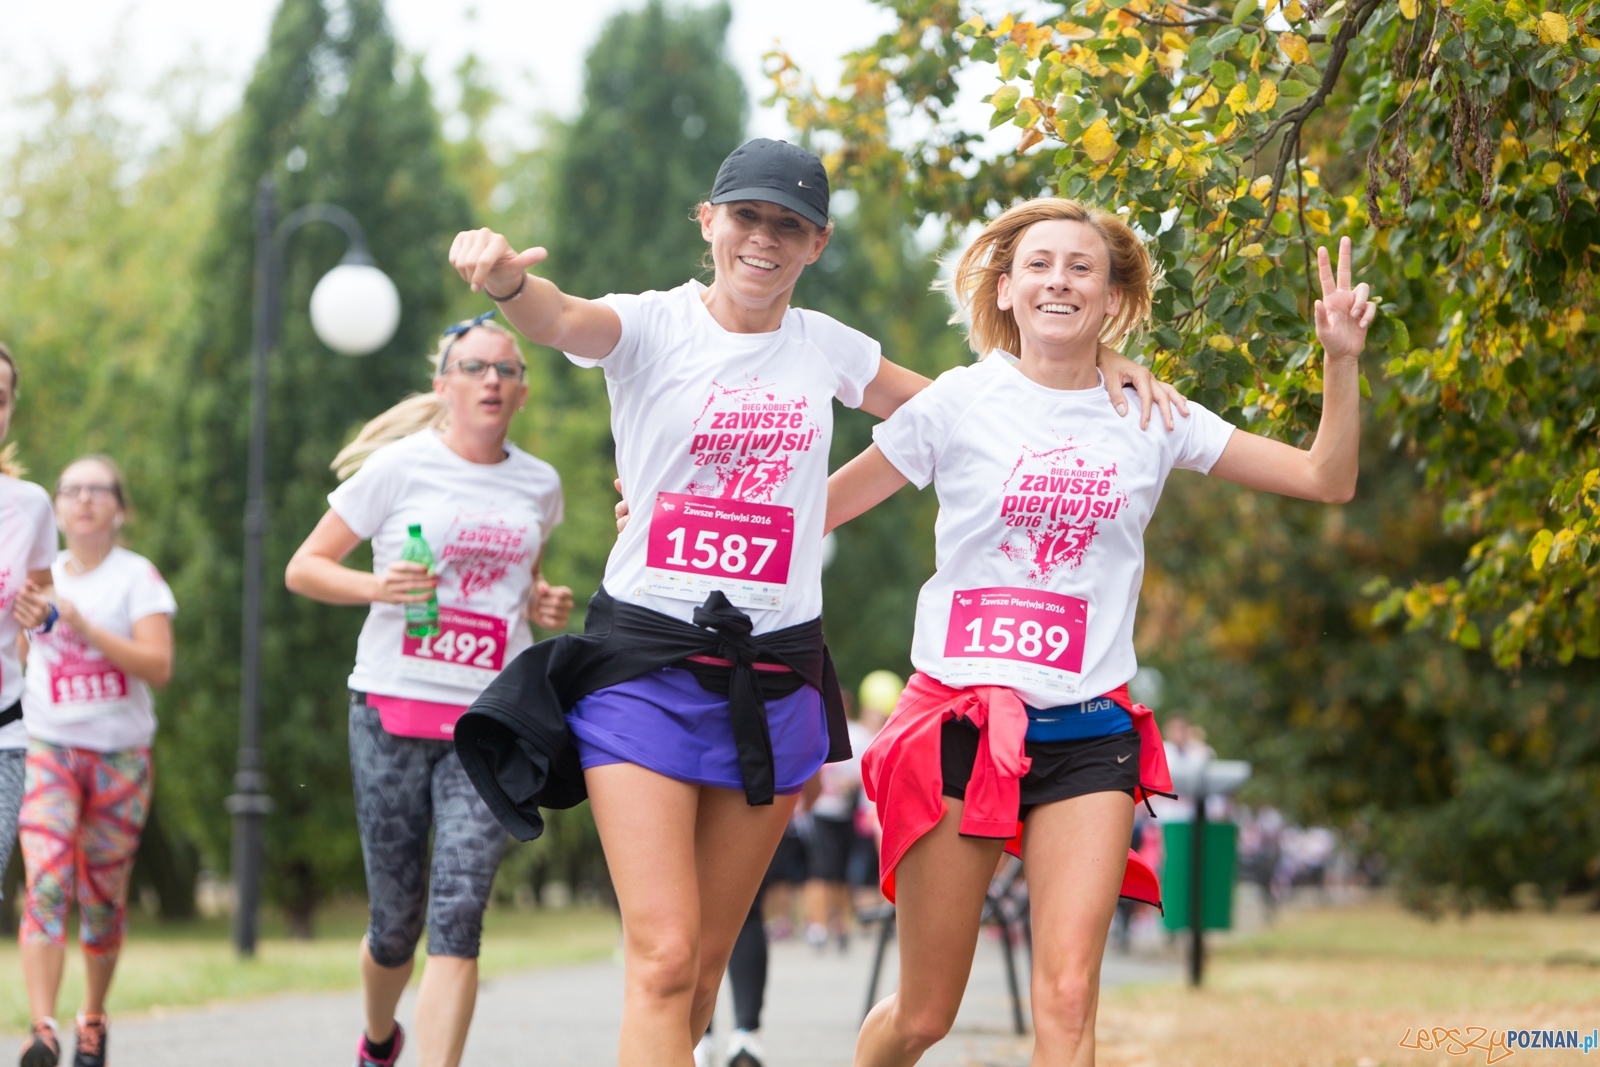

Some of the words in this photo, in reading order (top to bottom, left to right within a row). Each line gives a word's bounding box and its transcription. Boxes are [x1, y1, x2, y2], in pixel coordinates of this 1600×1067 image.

[742, 403, 761, 411] BIEG
[762, 403, 792, 411] KOBIET
[710, 411, 803, 430] zawsze
[689, 428, 815, 458] pier(w)si!
[694, 452, 733, 467] 2016
[1050, 467, 1070, 477] BIEG
[1070, 469, 1101, 479] KOBIET
[1019, 474, 1111, 497] zawsze
[683, 505, 714, 519] Zawsze
[714, 509, 750, 525] Pier(w)si
[750, 513, 772, 526] 2016
[1000, 494, 1122, 524] pier(w)si!
[1005, 514, 1043, 528] 2016
[665, 526, 778, 576] 1587
[980, 597, 1010, 607] Zawsze
[1010, 598, 1045, 611] Pier(w)si
[1045, 602, 1066, 614] 2016
[414, 629, 498, 669] 1492
[963, 616, 1070, 662] 1589
